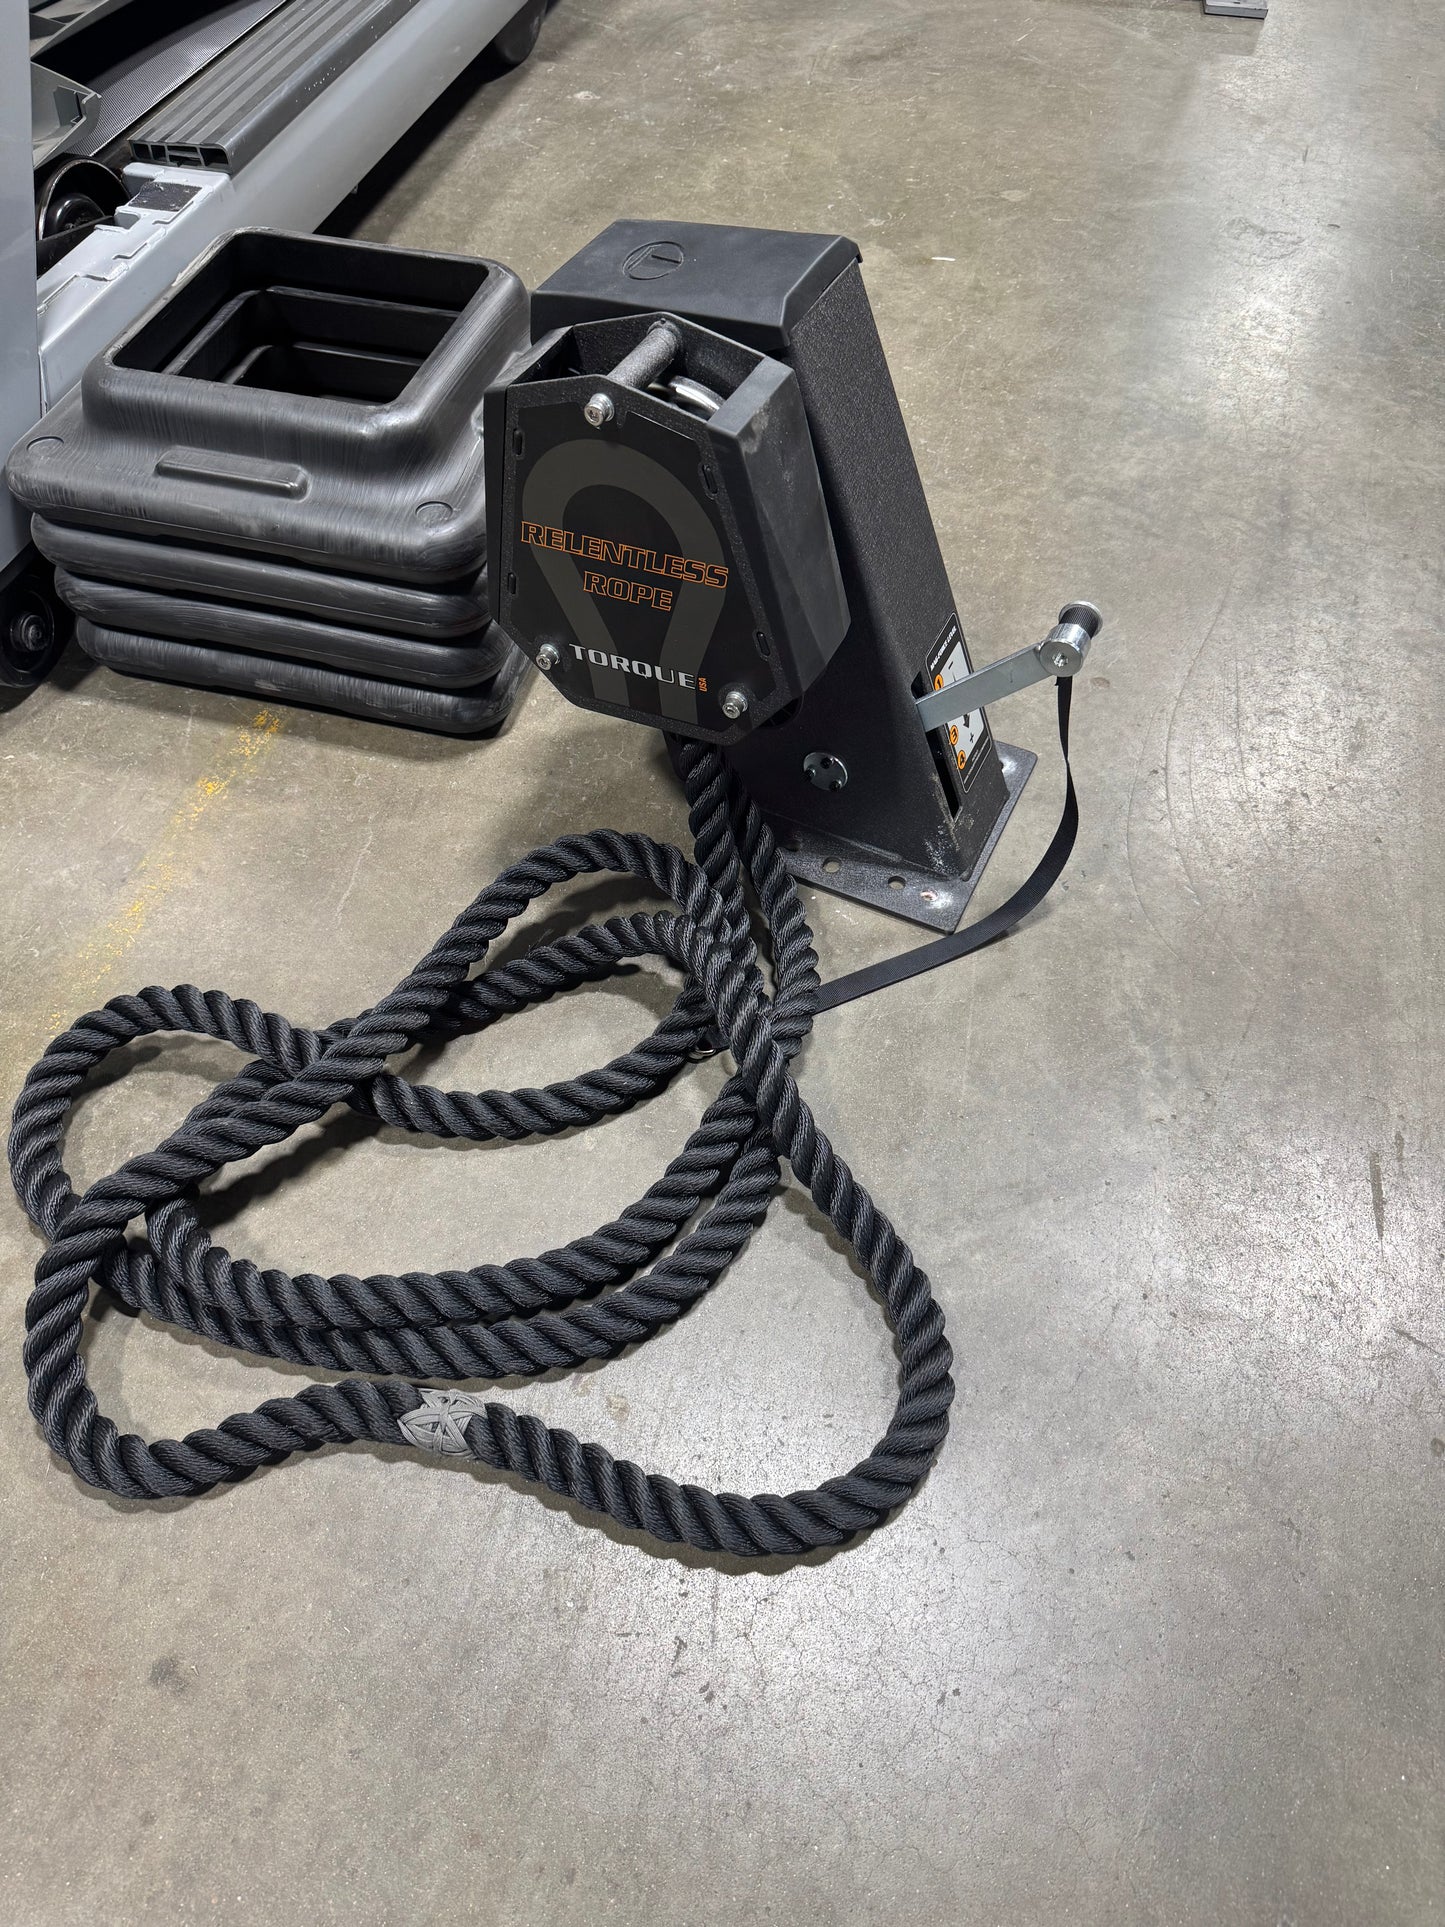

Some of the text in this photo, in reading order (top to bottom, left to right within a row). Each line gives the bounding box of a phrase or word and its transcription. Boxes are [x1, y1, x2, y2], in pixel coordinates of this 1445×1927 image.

[521, 521, 729, 589] RELENTLESS
[583, 571, 673, 611] ROPE
[569, 643, 696, 690] TORQUE
[698, 677, 708, 692] USA
